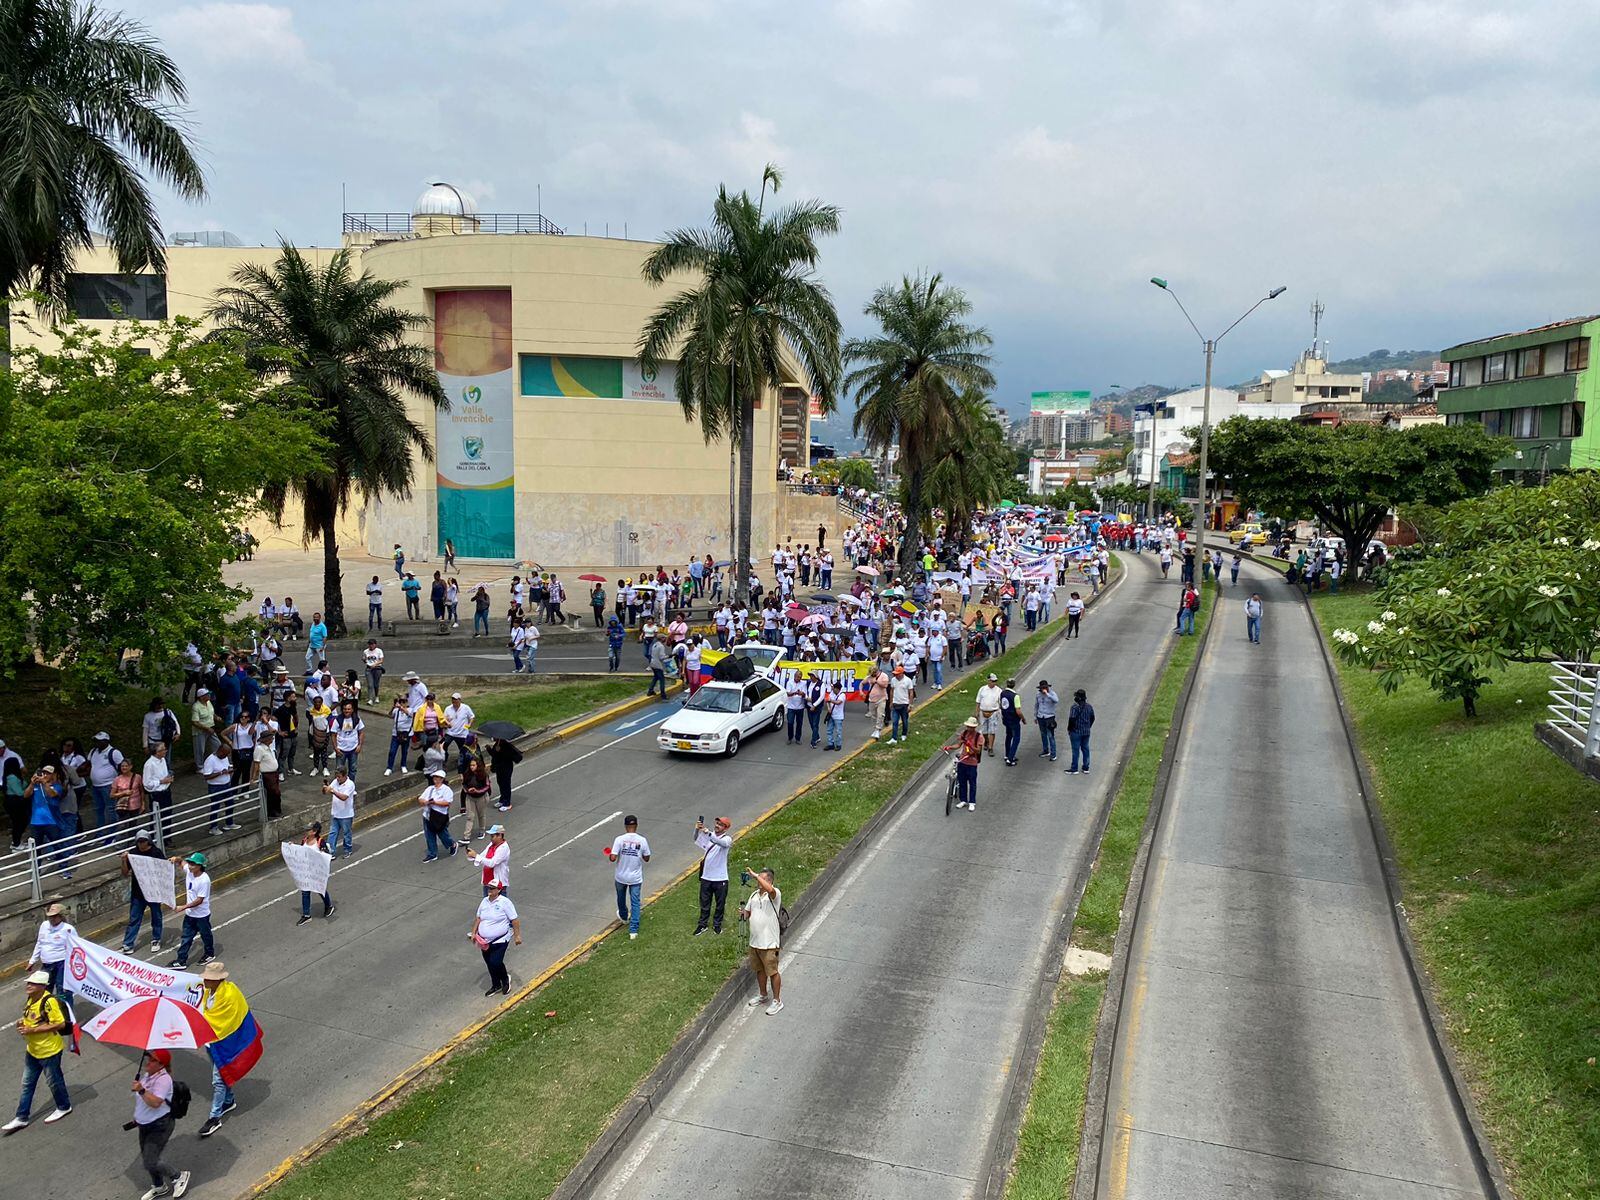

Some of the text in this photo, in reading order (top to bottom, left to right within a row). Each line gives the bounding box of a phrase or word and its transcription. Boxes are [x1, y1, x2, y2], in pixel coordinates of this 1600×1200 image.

[632, 390, 666, 398] Invencible
[462, 406, 483, 414] Valle
[452, 414, 494, 424] Invencible
[102, 956, 176, 987] SINTRAMUNICIPIO
[110, 976, 122, 989] DE
[80, 983, 110, 1004] PRESENTE
